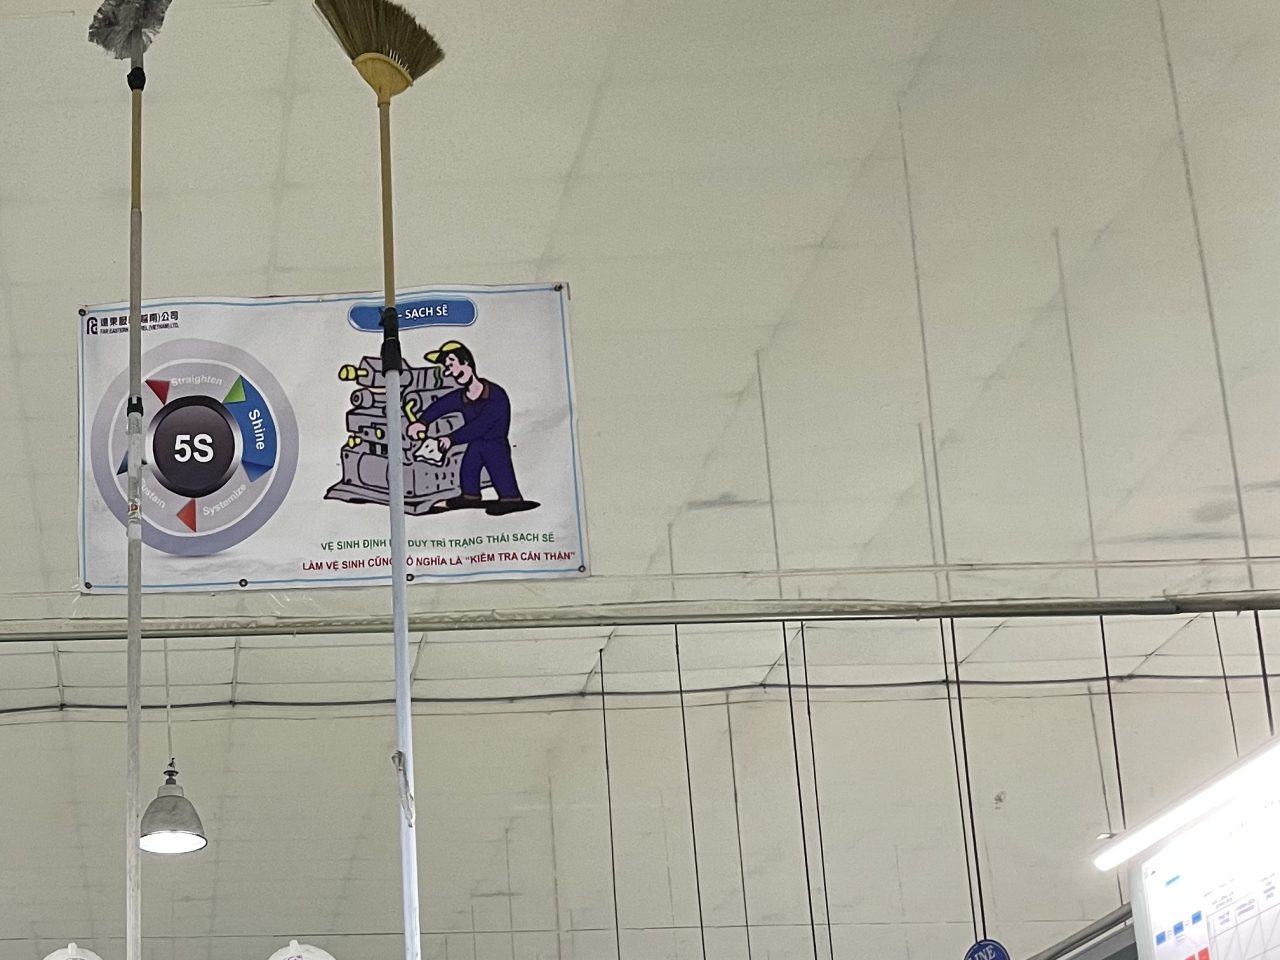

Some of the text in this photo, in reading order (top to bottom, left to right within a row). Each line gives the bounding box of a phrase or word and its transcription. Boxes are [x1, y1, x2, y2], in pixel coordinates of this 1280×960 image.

[405, 304, 448, 321] SẠCH SẼ
[171, 374, 223, 387] Straighten
[248, 409, 265, 450] Shine
[174, 433, 214, 463] 5S
[142, 478, 167, 509] ustain
[203, 483, 247, 517] Systemize
[337, 540, 360, 550] SINH
[363, 538, 386, 549] ĐỊNH
[408, 539, 427, 548] DUY
[448, 536, 483, 549] TRẠNG
[487, 532, 510, 544] THÁI
[513, 532, 539, 544] SẠCH
[303, 559, 323, 571] LÀM
[342, 559, 365, 570] SINH
[416, 556, 447, 567] NGHĨA
[449, 555, 463, 566] LÀ
[498, 552, 518, 562] TRA
